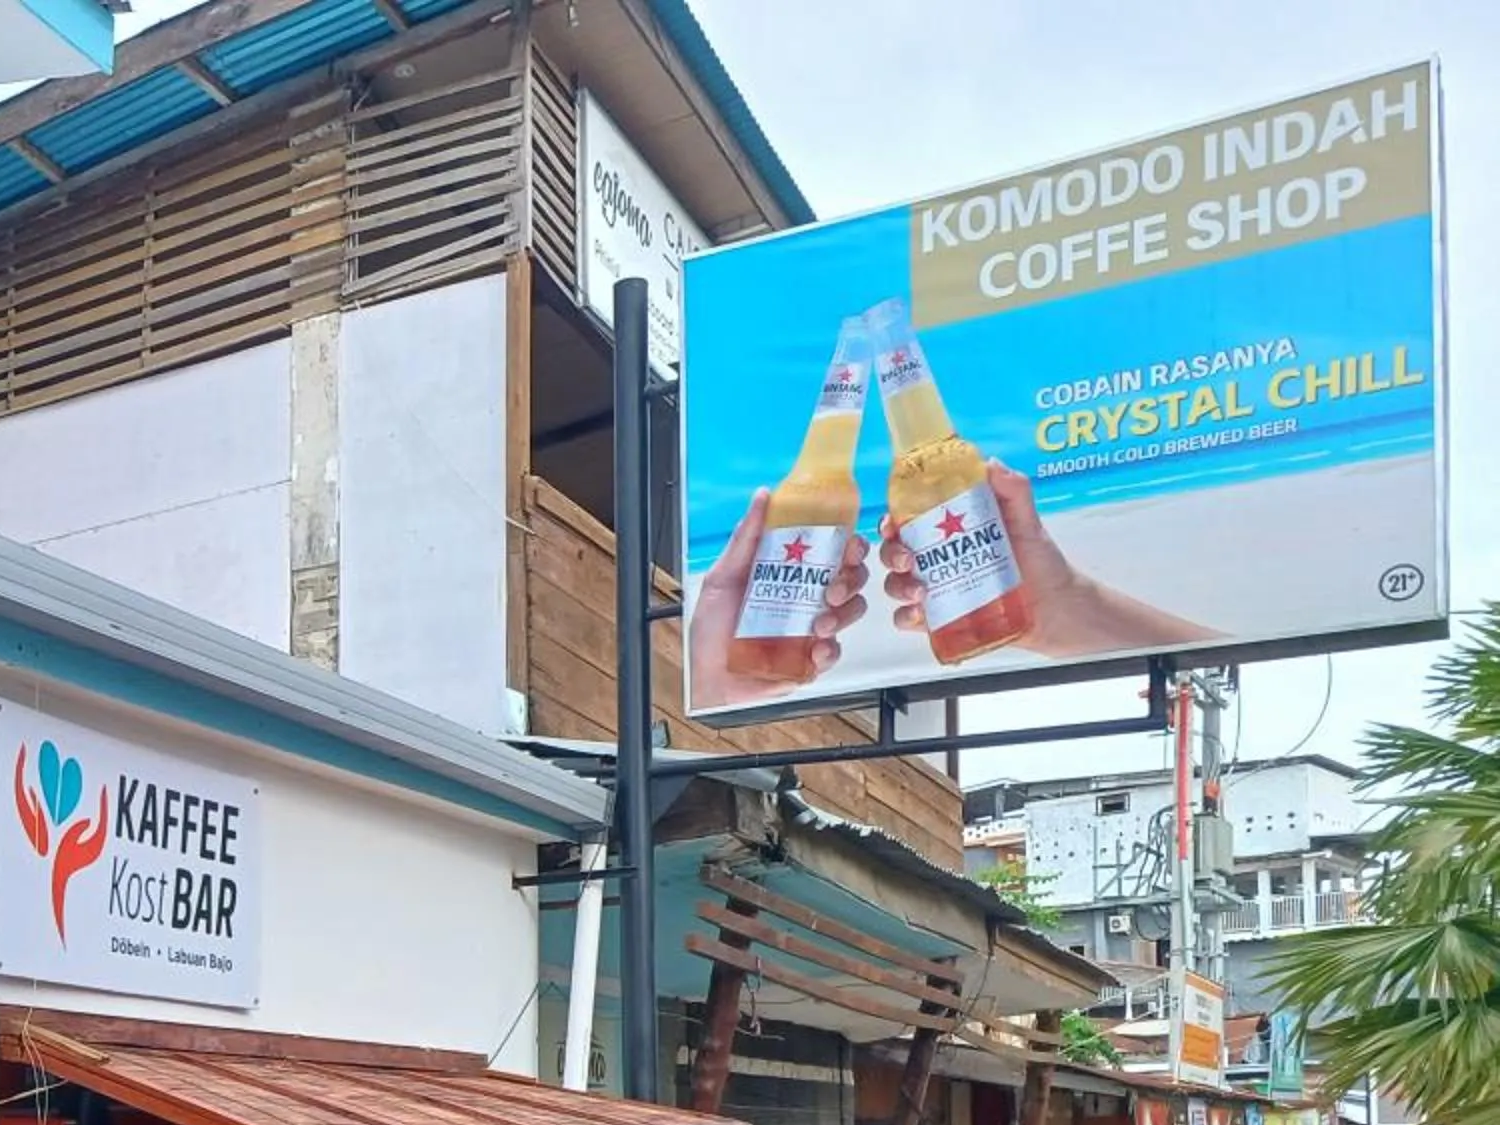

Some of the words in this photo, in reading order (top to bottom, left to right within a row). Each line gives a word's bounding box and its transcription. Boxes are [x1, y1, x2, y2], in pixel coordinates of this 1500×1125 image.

[921, 145, 1185, 253] KOMODO
[1203, 80, 1418, 181] INDAH
[978, 212, 1169, 299] COFFE
[1186, 166, 1368, 251] SHOP
[1035, 369, 1142, 409] COBAIN
[1150, 337, 1297, 387] RASANYA
[1035, 381, 1254, 453] CRYSTAL
[1266, 345, 1425, 409] CHILL
[1036, 451, 1111, 478] SMOOTH
[1112, 442, 1161, 466] COLD
[1163, 427, 1244, 457] BREWED
[1249, 417, 1299, 440] BEER
[754, 562, 831, 587] BINTANG
[914, 523, 1004, 572] BINTANG
[929, 546, 1001, 584] CRYSTAL
[115, 774, 240, 865] KAFFEE
[167, 946, 207, 969] Labuan
[209, 953, 233, 974] Bajo
